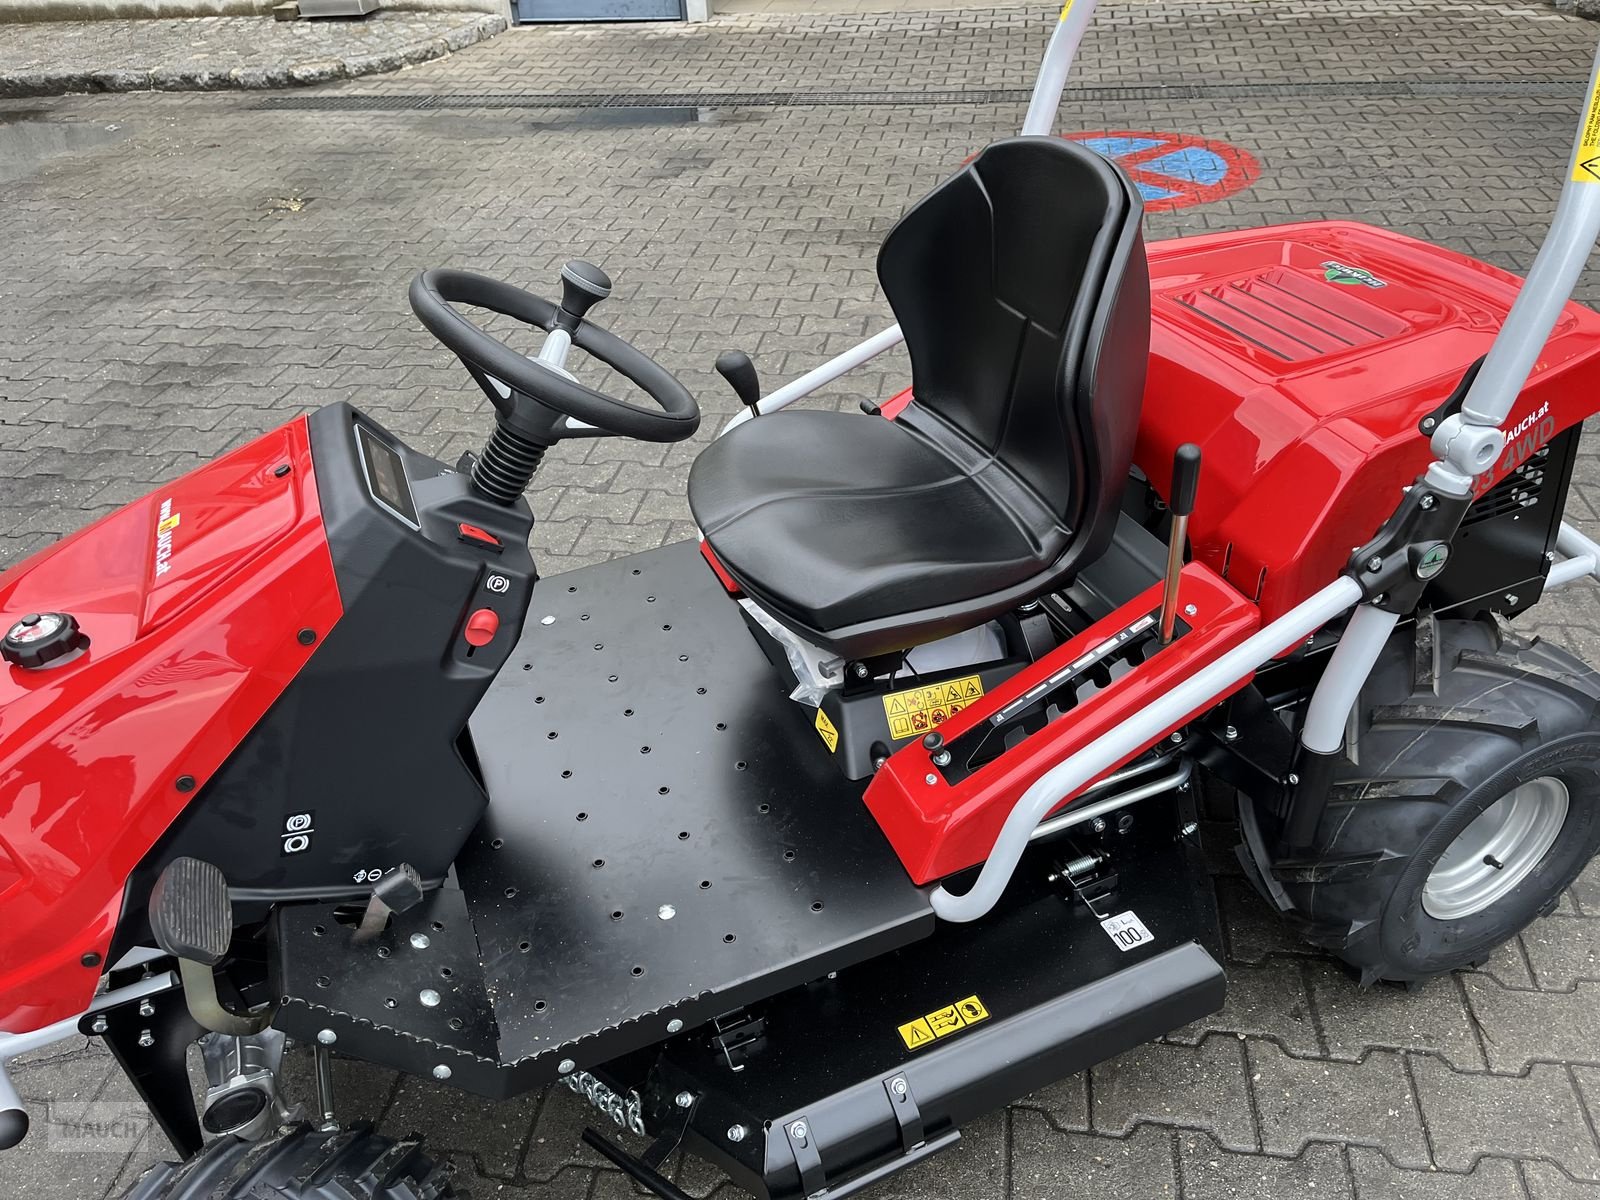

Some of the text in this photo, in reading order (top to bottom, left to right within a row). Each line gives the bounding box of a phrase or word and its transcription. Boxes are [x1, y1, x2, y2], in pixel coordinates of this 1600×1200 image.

[1502, 415, 1556, 471] 4WD
[1503, 400, 1549, 446] AUCH.at
[1113, 926, 1143, 947] 100
